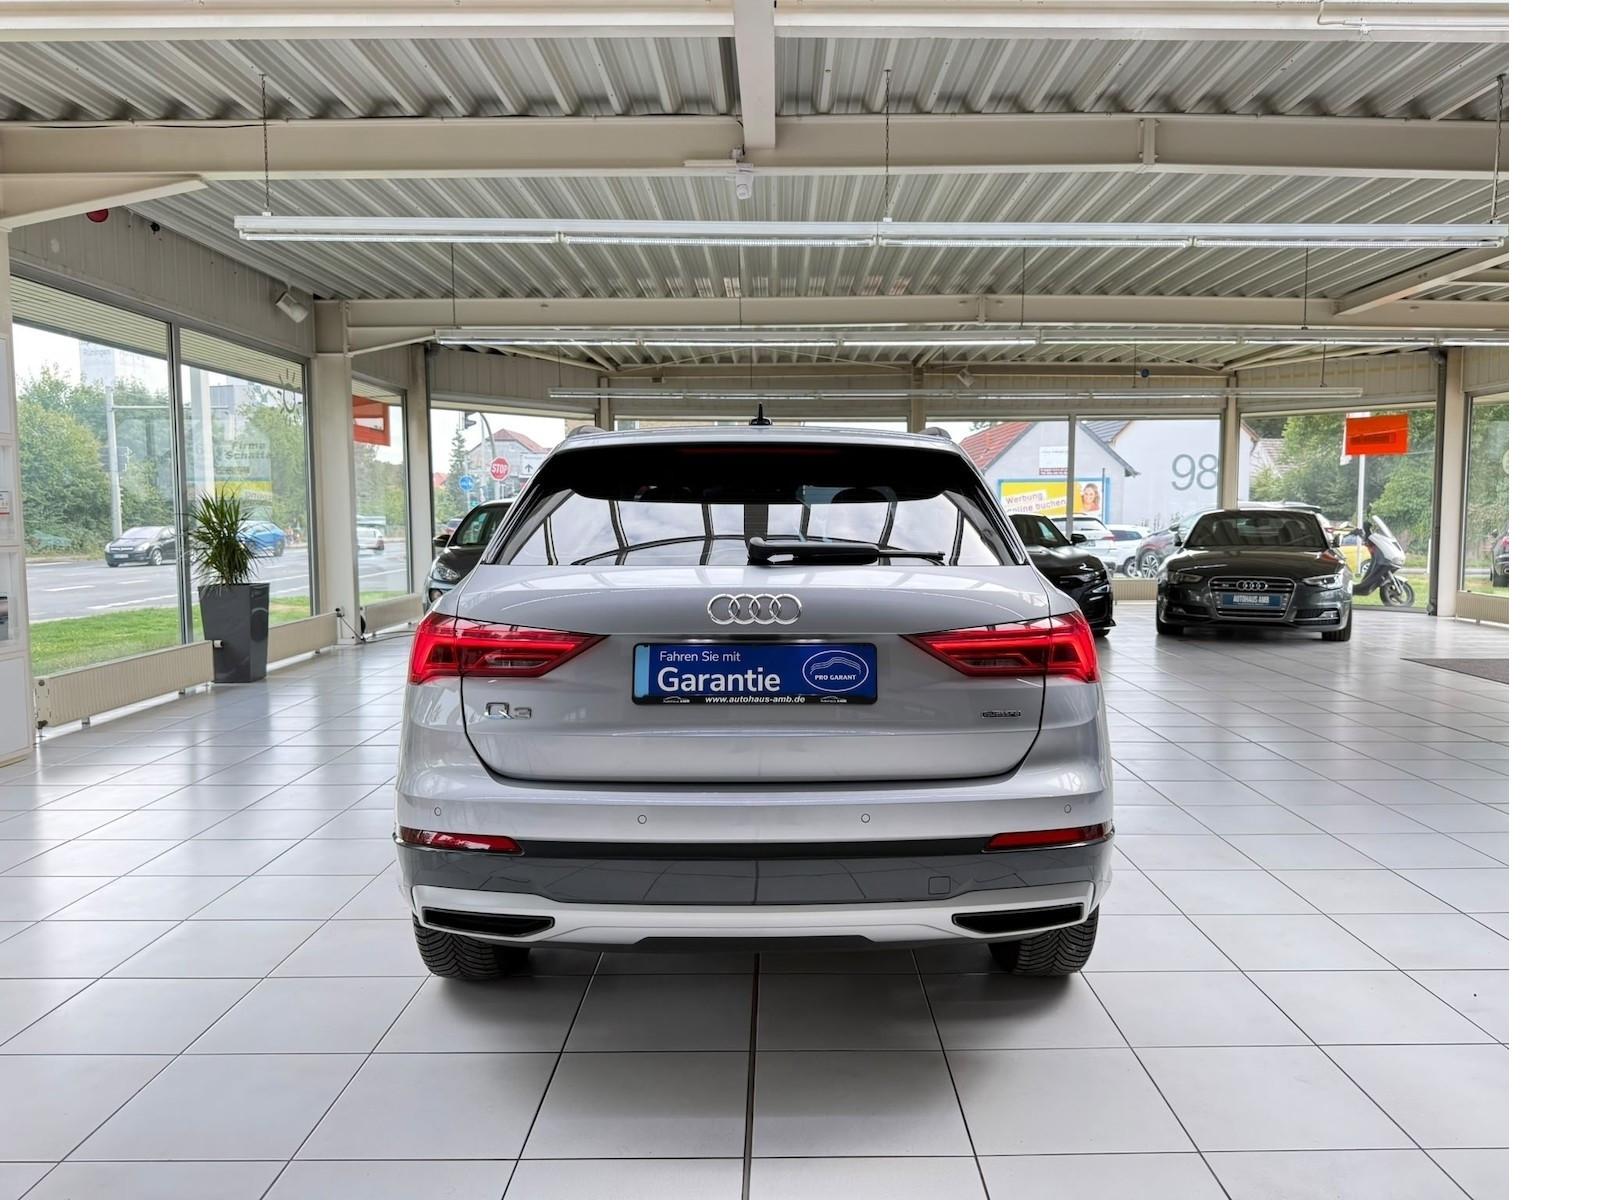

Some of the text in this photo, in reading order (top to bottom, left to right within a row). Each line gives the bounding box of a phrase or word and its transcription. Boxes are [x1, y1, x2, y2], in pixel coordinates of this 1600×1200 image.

[492, 463, 508, 474] STOP
[1172, 453, 1219, 491] 98
[1006, 493, 1044, 505] Werbung
[660, 651, 741, 662] Fahren Sie mit
[657, 666, 781, 692] Garantie
[705, 695, 806, 704] www.autohaus-amb.de
[485, 702, 532, 720] Q3
